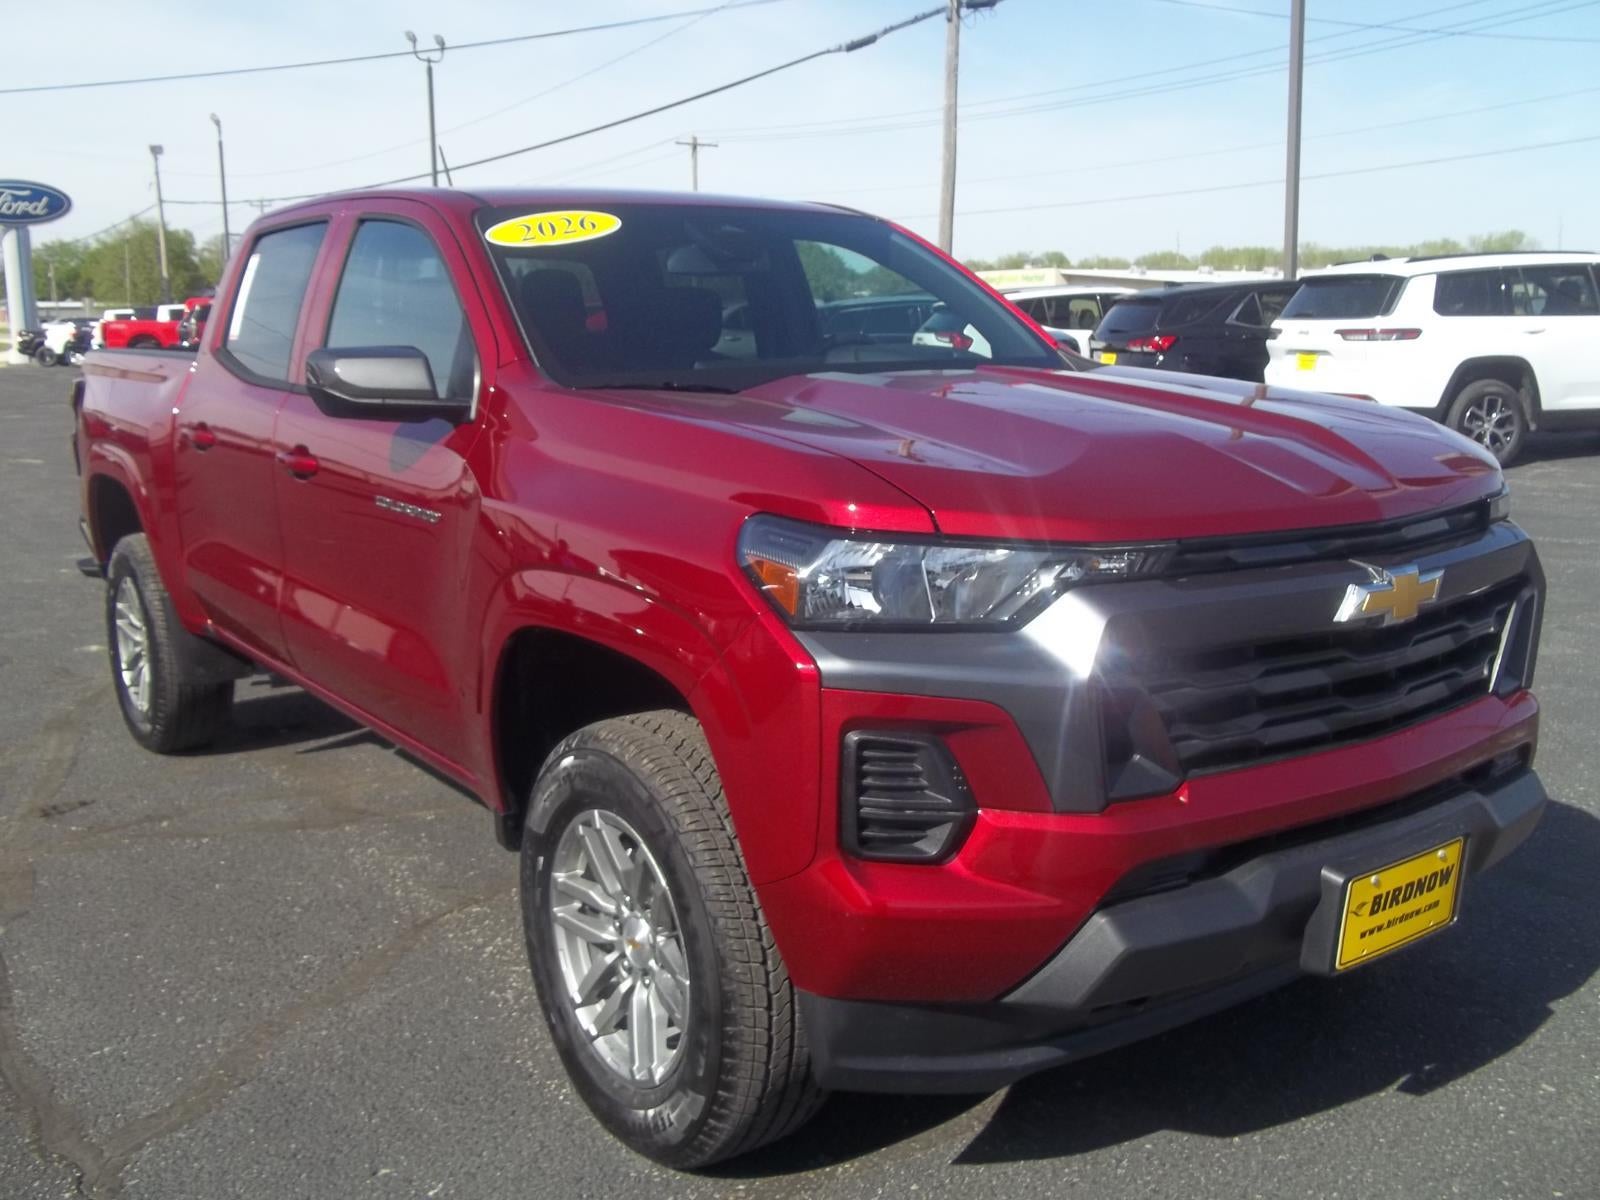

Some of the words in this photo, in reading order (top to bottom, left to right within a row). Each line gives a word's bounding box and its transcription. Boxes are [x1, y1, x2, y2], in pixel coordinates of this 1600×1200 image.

[518, 216, 597, 241] 2026
[1369, 864, 1455, 917] BIRDNOW
[1360, 899, 1440, 939] www.birdnow.com
